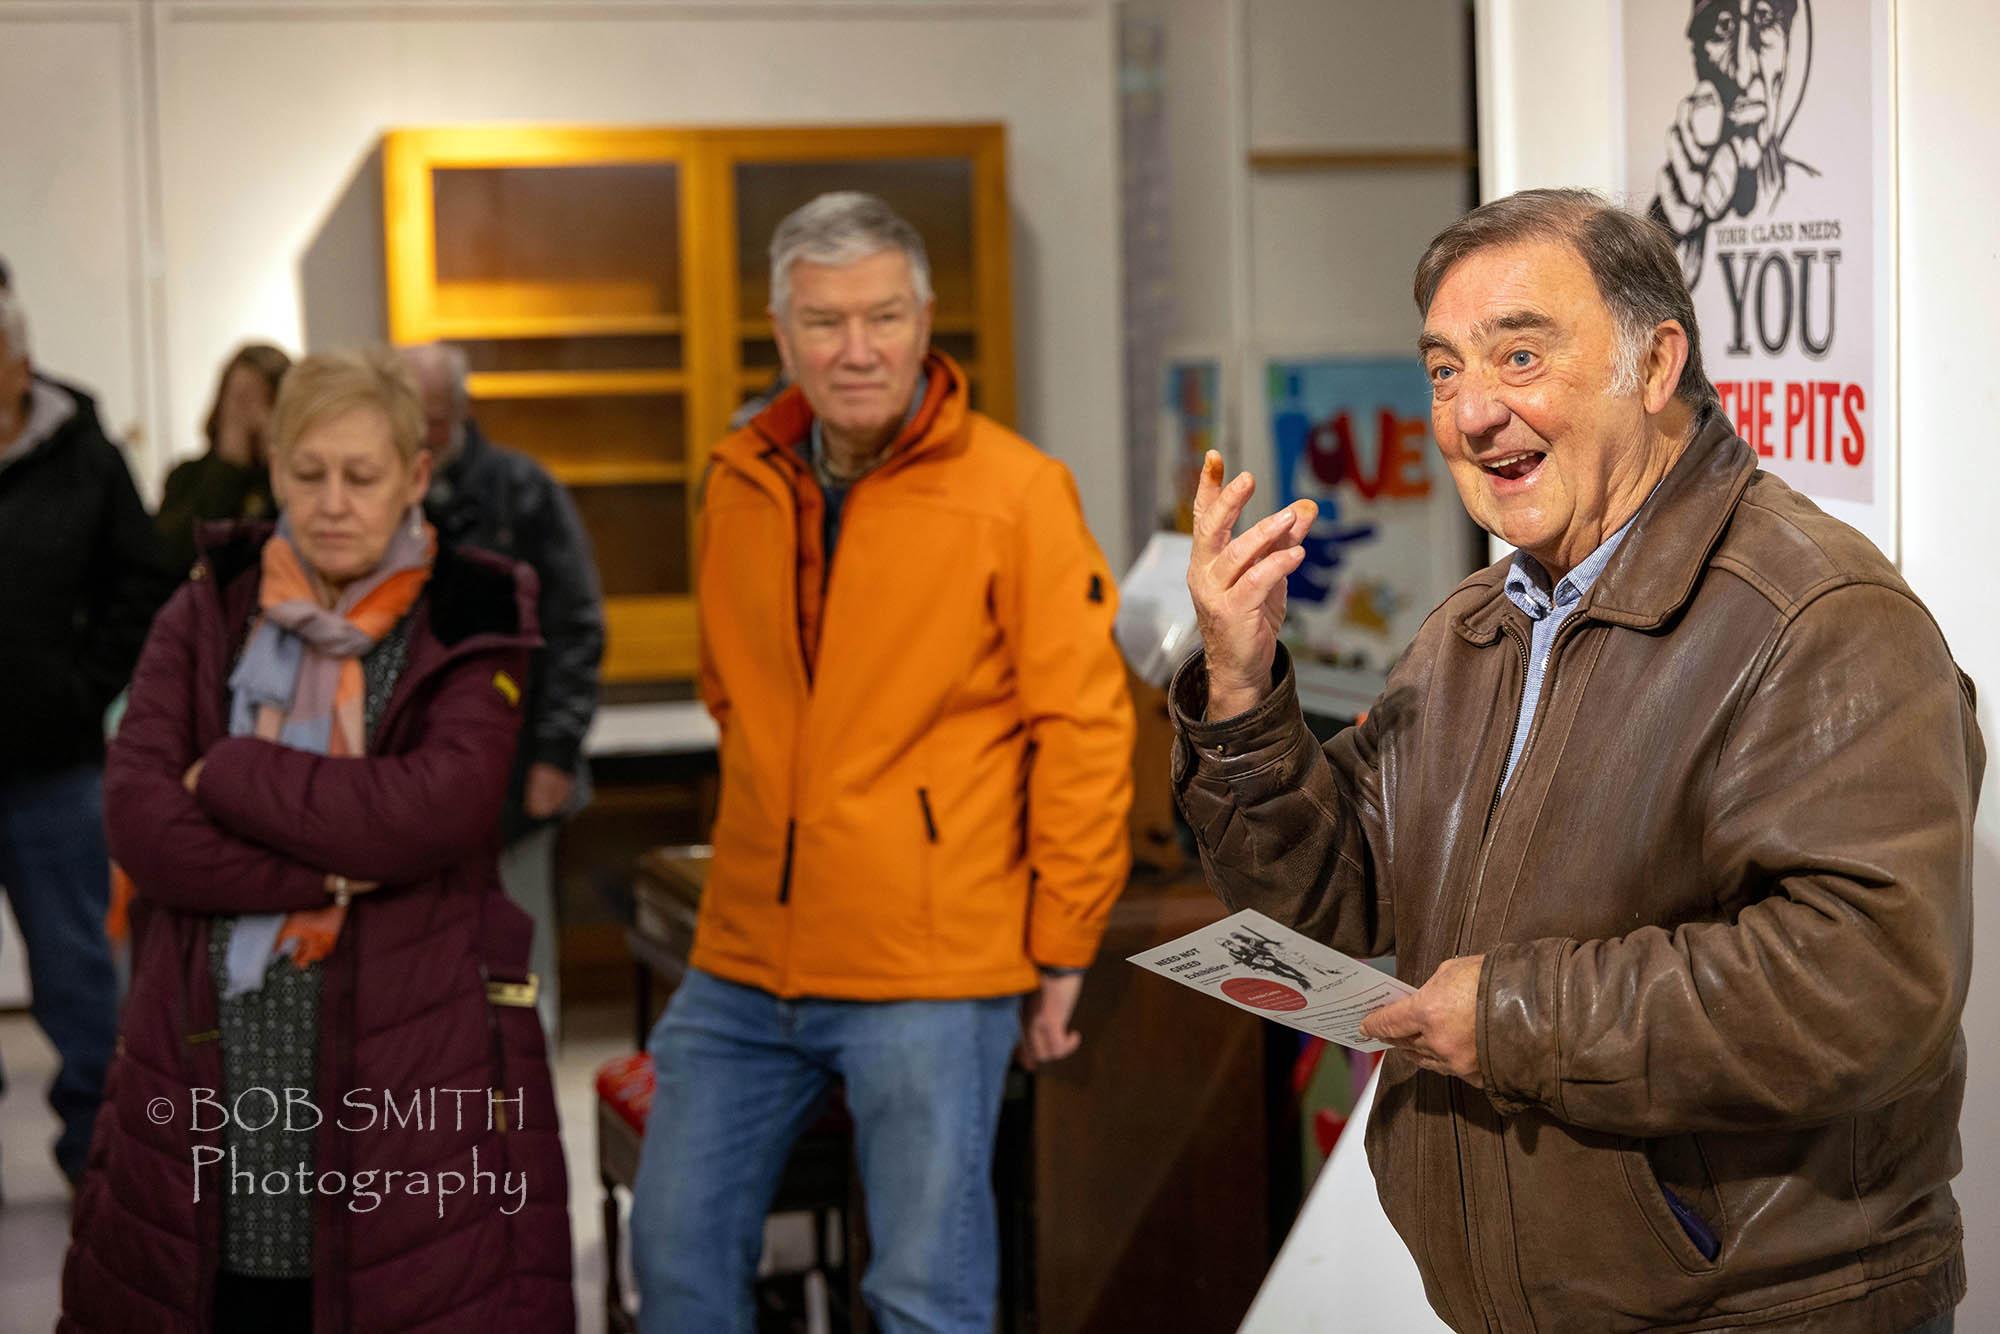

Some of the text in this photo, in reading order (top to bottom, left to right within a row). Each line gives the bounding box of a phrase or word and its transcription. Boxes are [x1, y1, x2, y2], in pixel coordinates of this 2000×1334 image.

[1716, 220, 1842, 246] YOUR CLASS NEEDS
[1717, 249, 1842, 361] YOU
[1785, 380, 1866, 468] PITS
[1154, 947, 1201, 967] NEED NOT
[1169, 960, 1202, 973] GREED
[1183, 963, 1230, 980] Exhibition
